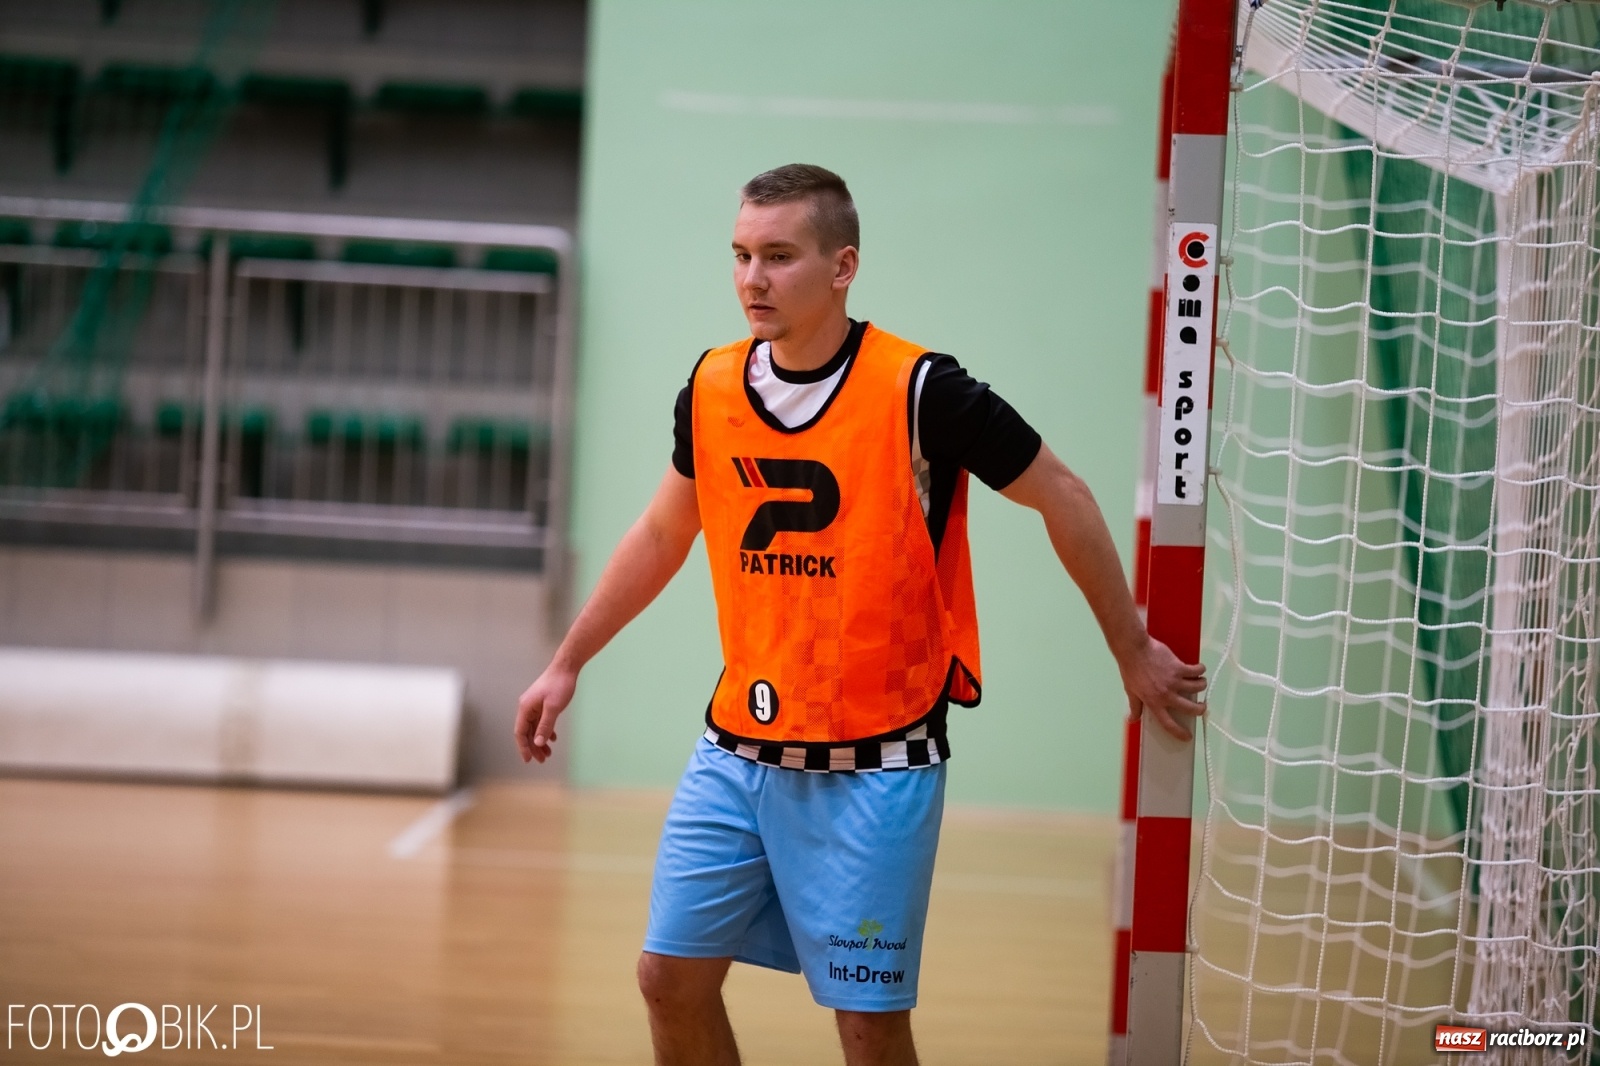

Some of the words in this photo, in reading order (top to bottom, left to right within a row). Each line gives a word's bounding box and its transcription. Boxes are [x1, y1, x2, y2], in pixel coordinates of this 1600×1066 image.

[1174, 370, 1194, 499] sport
[739, 551, 837, 578] PATRICK
[755, 682, 771, 721] 9
[872, 937, 908, 951] Wood
[829, 961, 905, 984] Int-Drew
